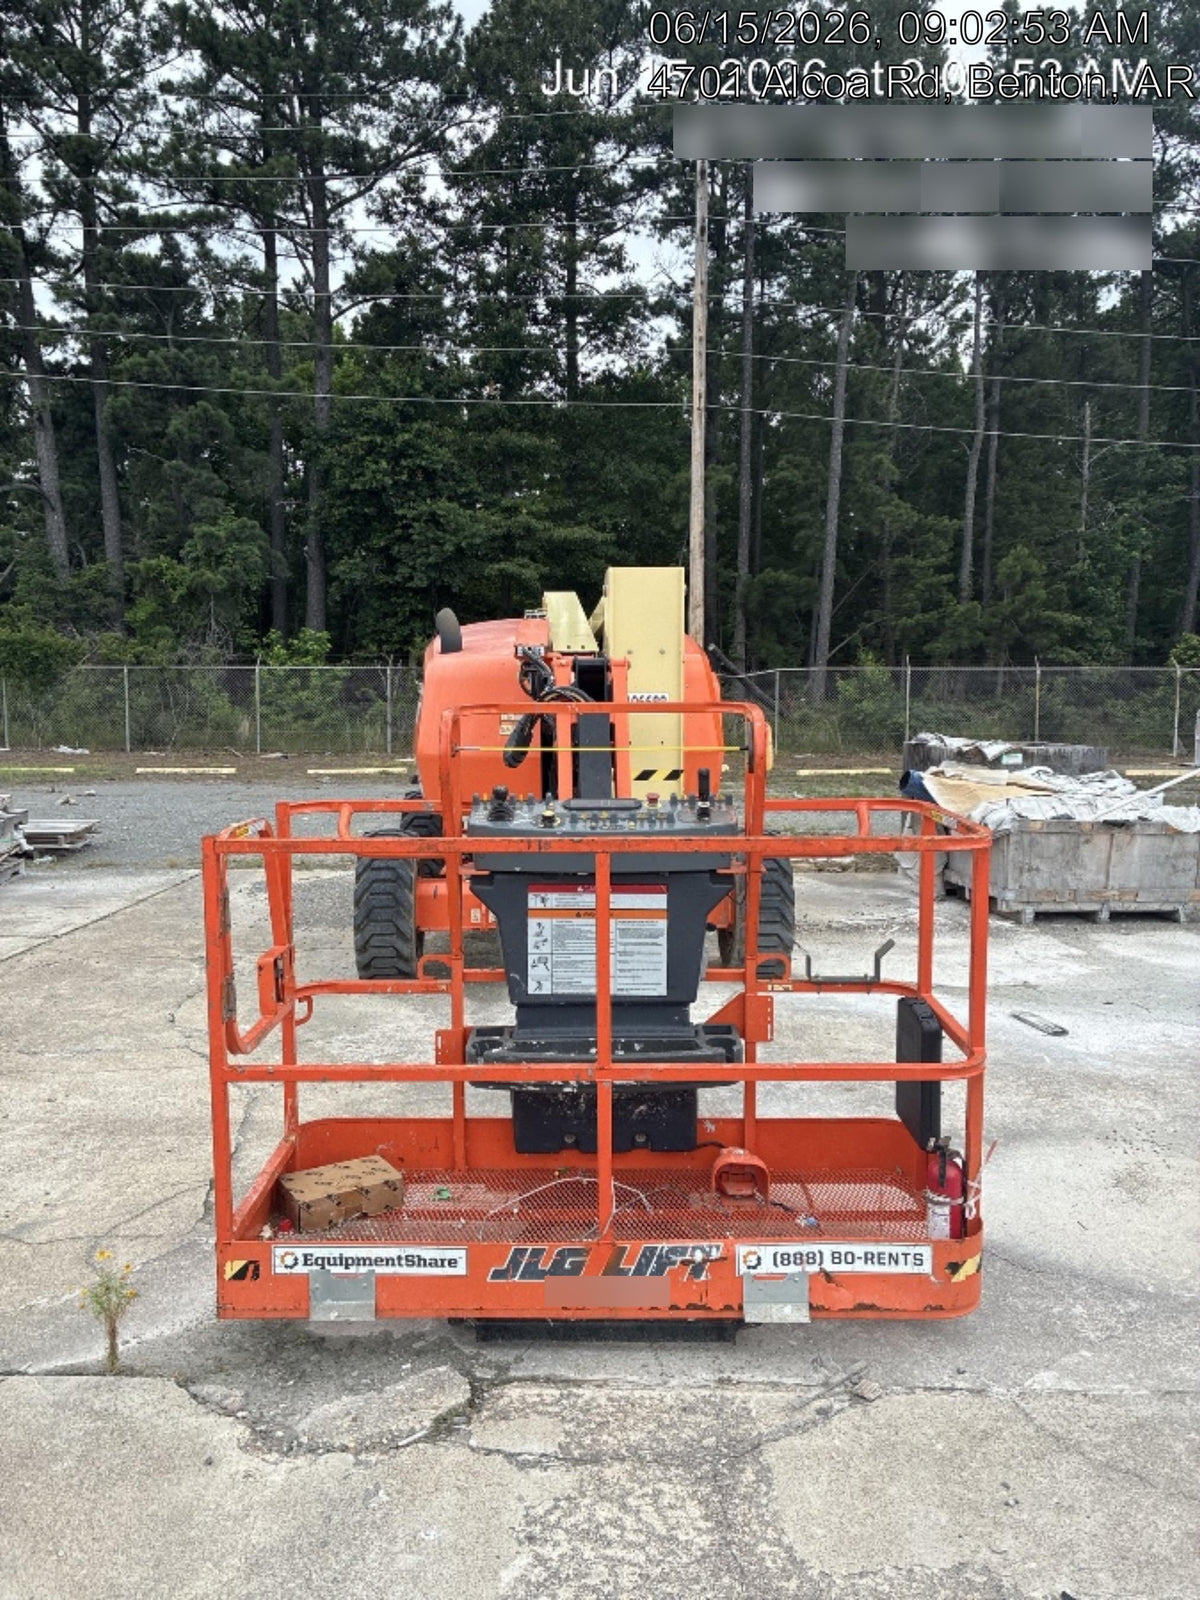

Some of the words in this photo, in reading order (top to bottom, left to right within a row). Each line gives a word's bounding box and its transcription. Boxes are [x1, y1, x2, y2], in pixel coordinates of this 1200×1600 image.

[302, 1252, 459, 1270] EquipmentShare
[486, 1245, 593, 1282] JLG
[772, 1250, 824, 1268] (888)
